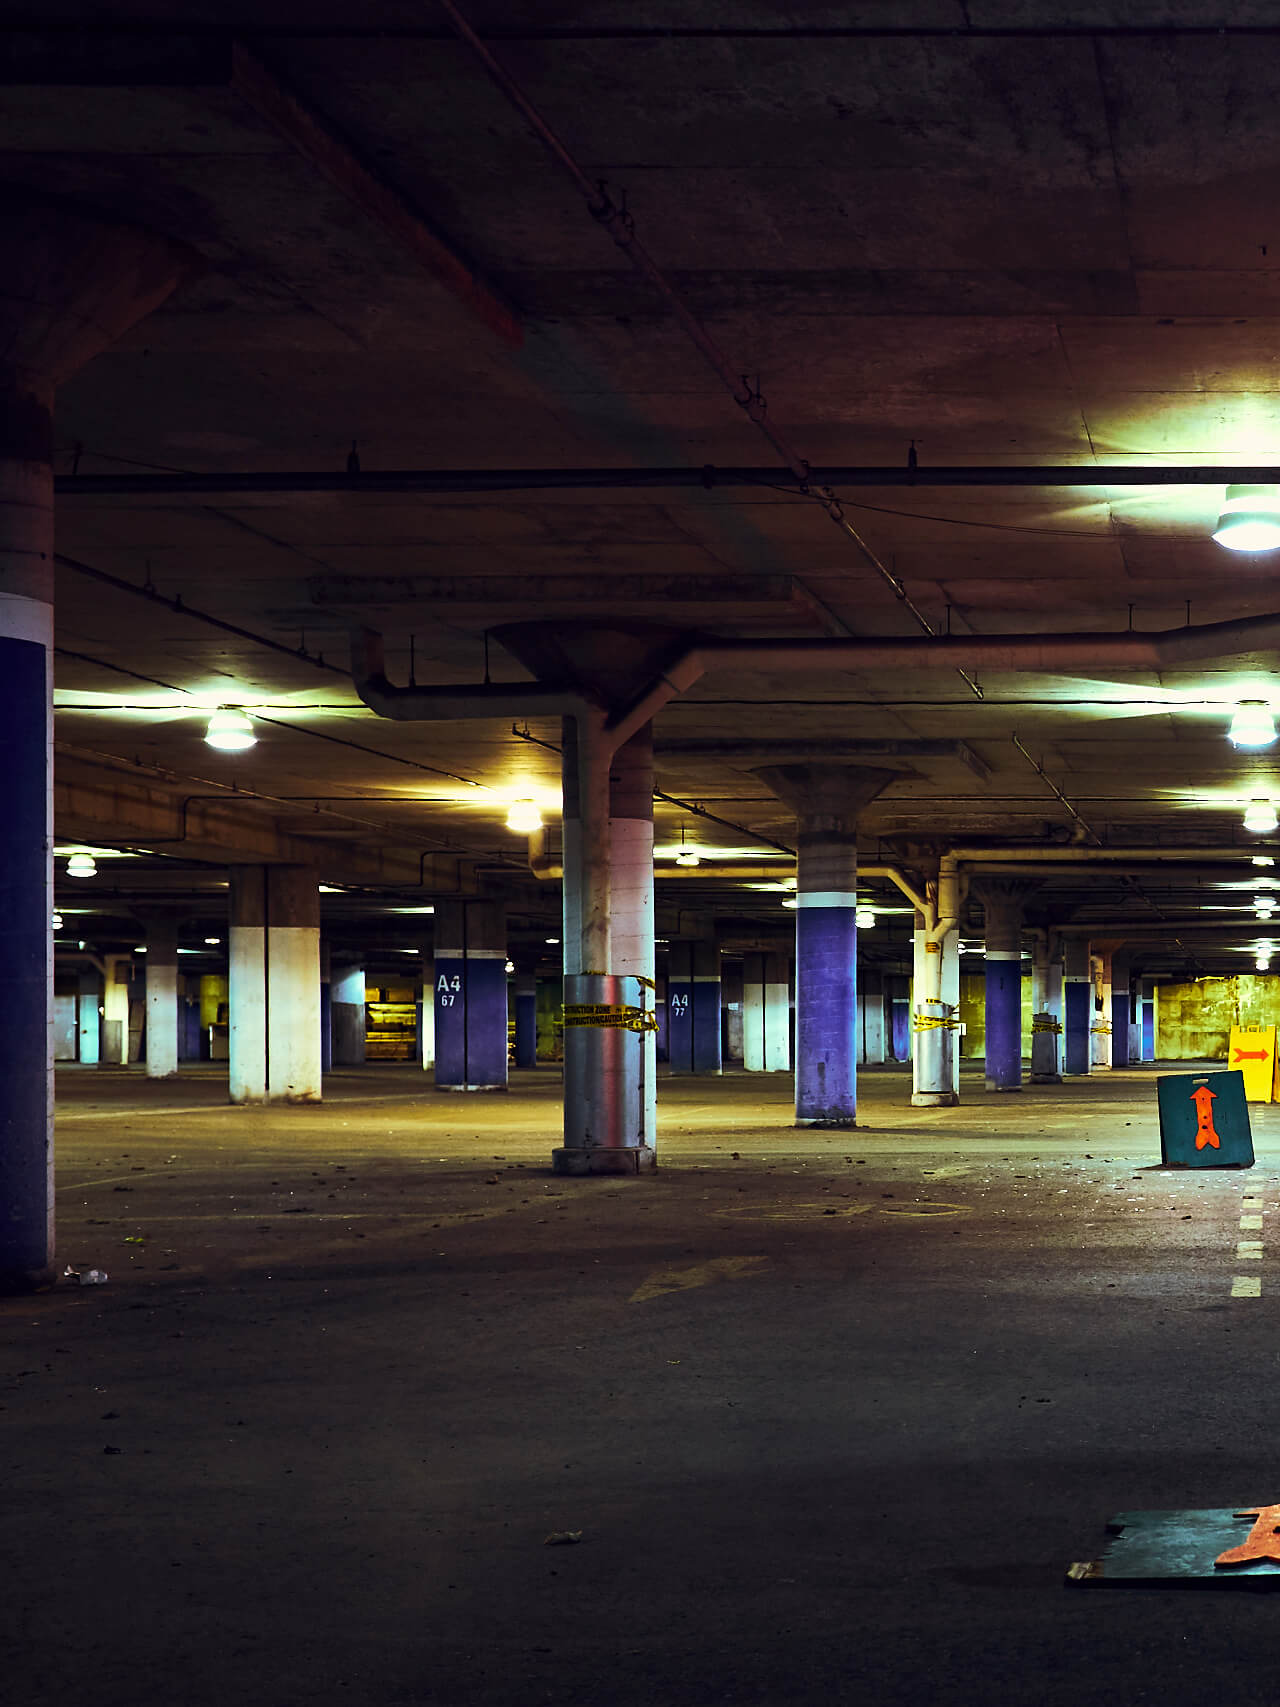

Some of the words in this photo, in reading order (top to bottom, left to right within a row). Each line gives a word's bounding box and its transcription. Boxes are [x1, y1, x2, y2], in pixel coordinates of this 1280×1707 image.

[437, 974, 461, 992] A4
[441, 995, 455, 1007] 67
[671, 993, 688, 1007] A4
[675, 1007, 685, 1017] 77
